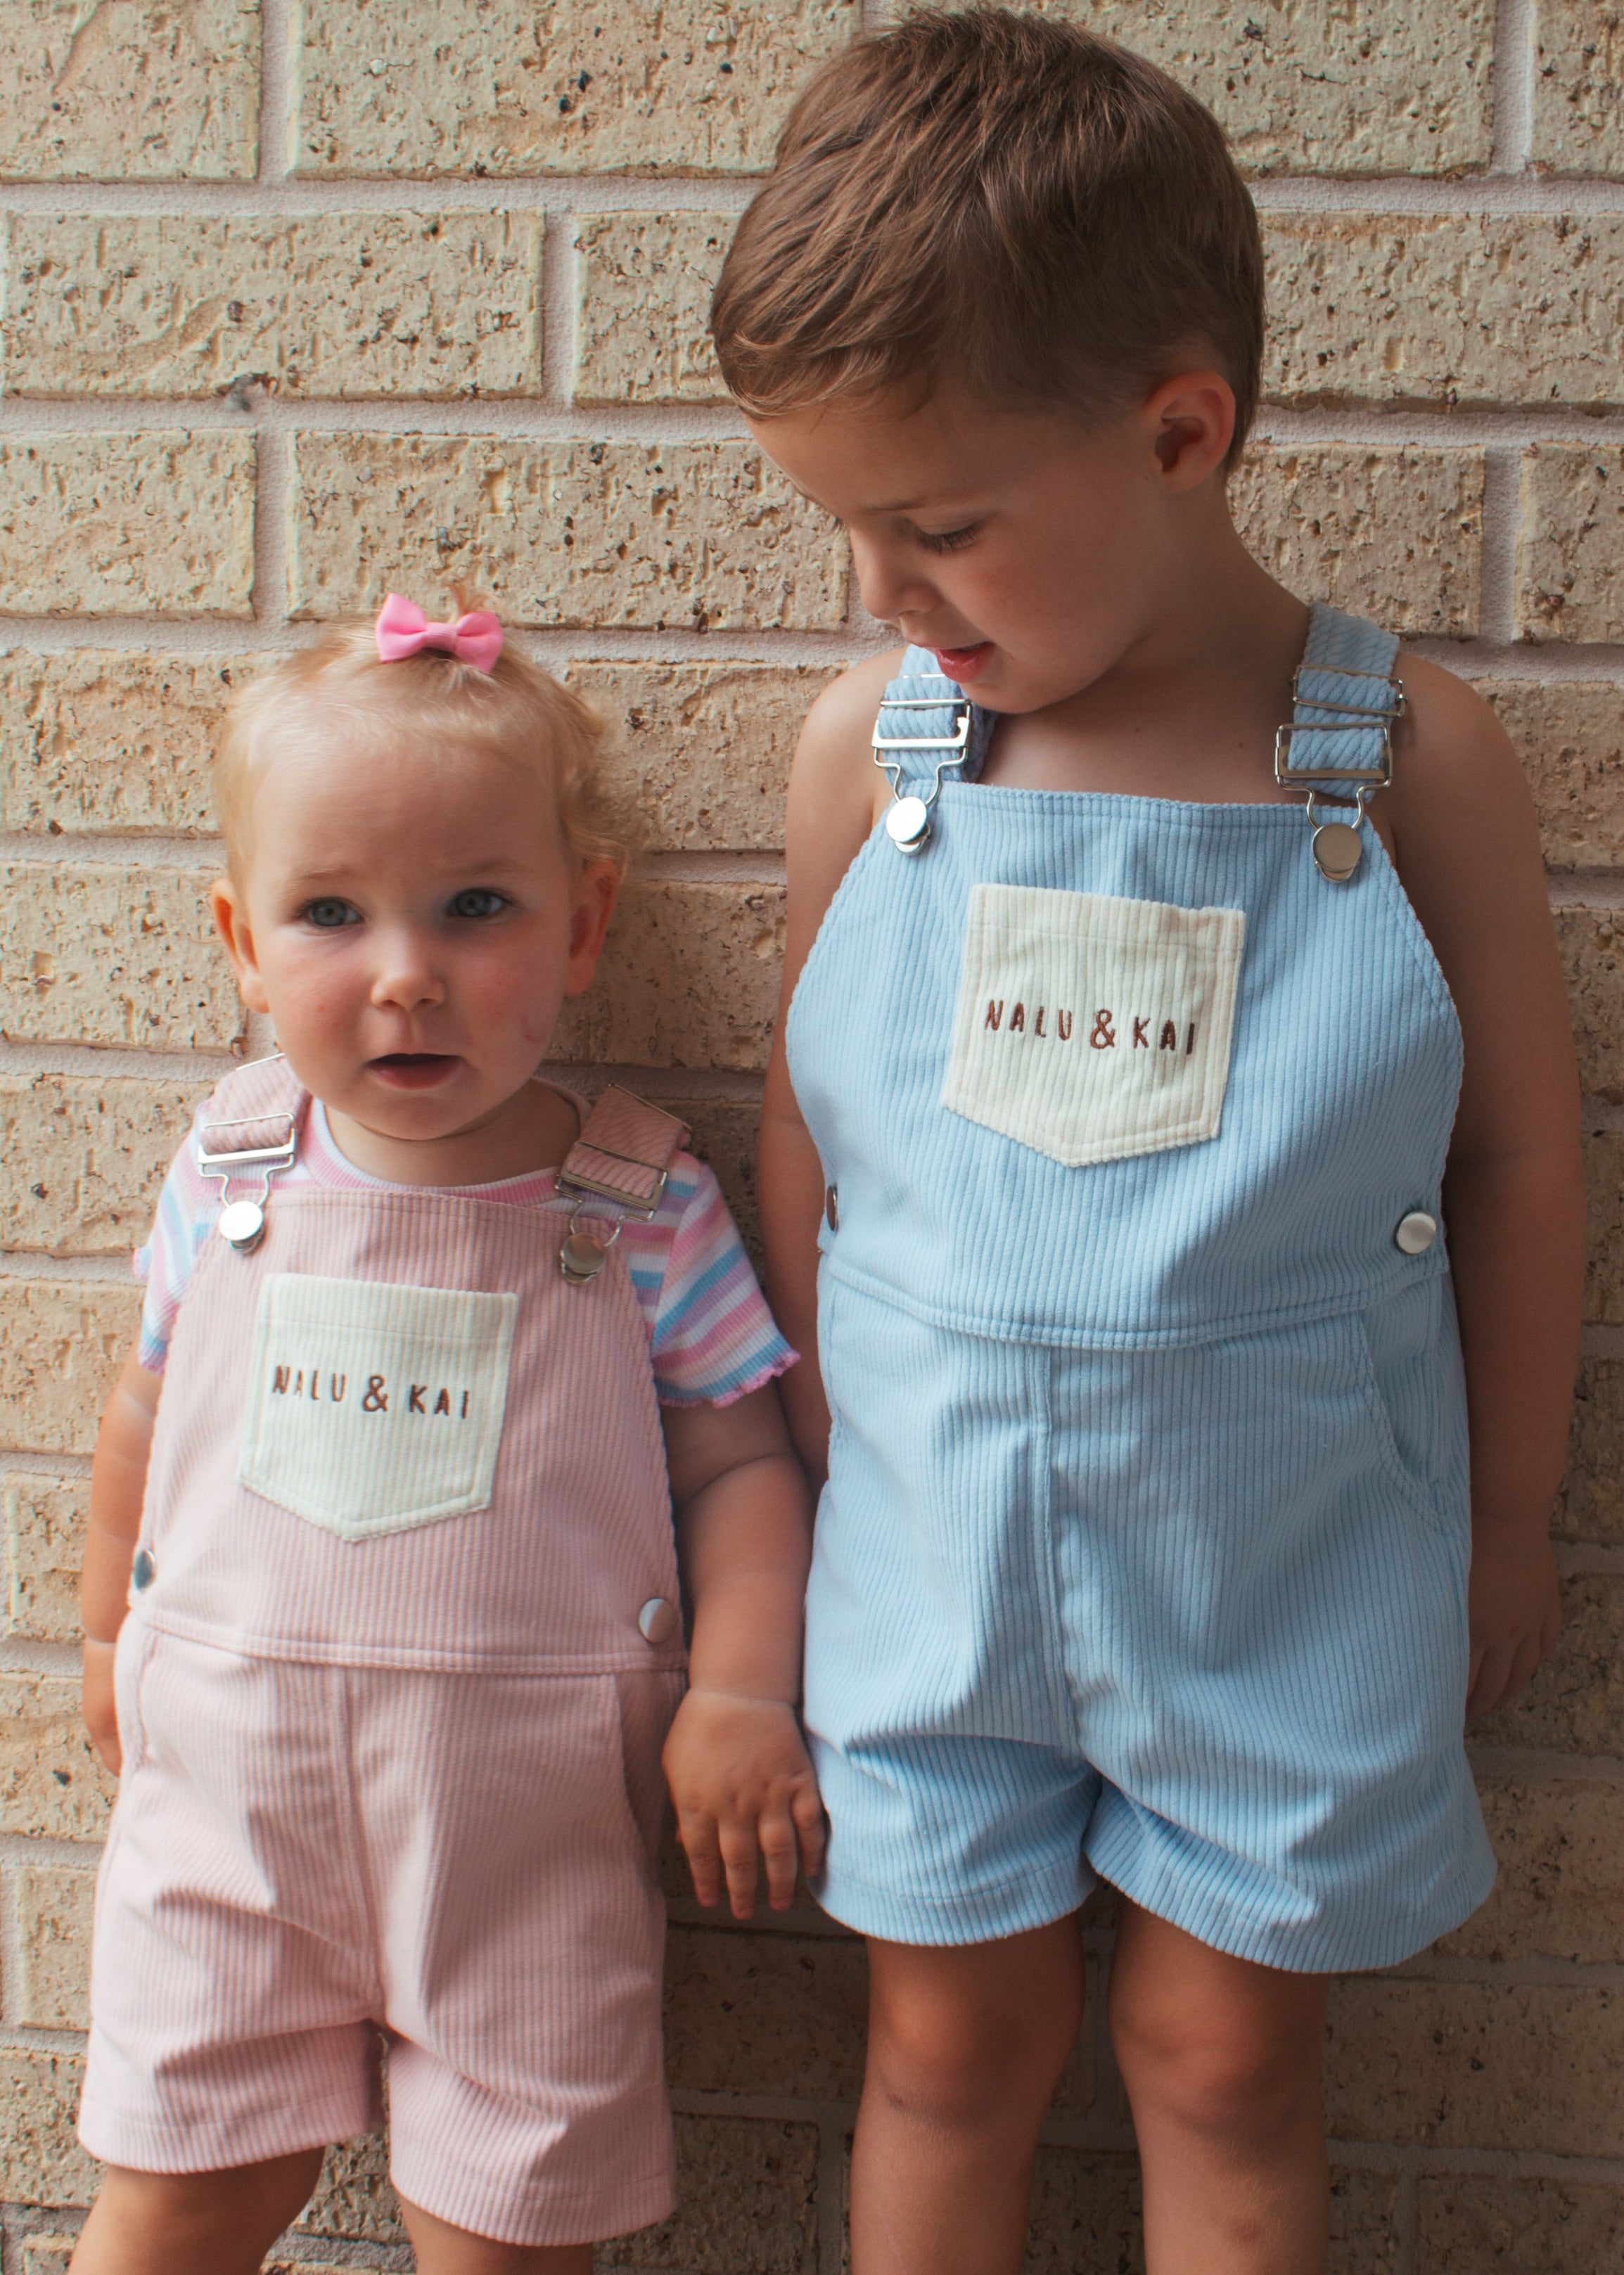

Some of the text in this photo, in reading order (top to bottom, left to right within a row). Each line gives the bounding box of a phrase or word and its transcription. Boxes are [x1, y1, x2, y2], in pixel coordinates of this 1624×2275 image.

[985, 999, 1195, 1055] NALU & KAI
[272, 1365, 469, 1418] NALU & KAI
